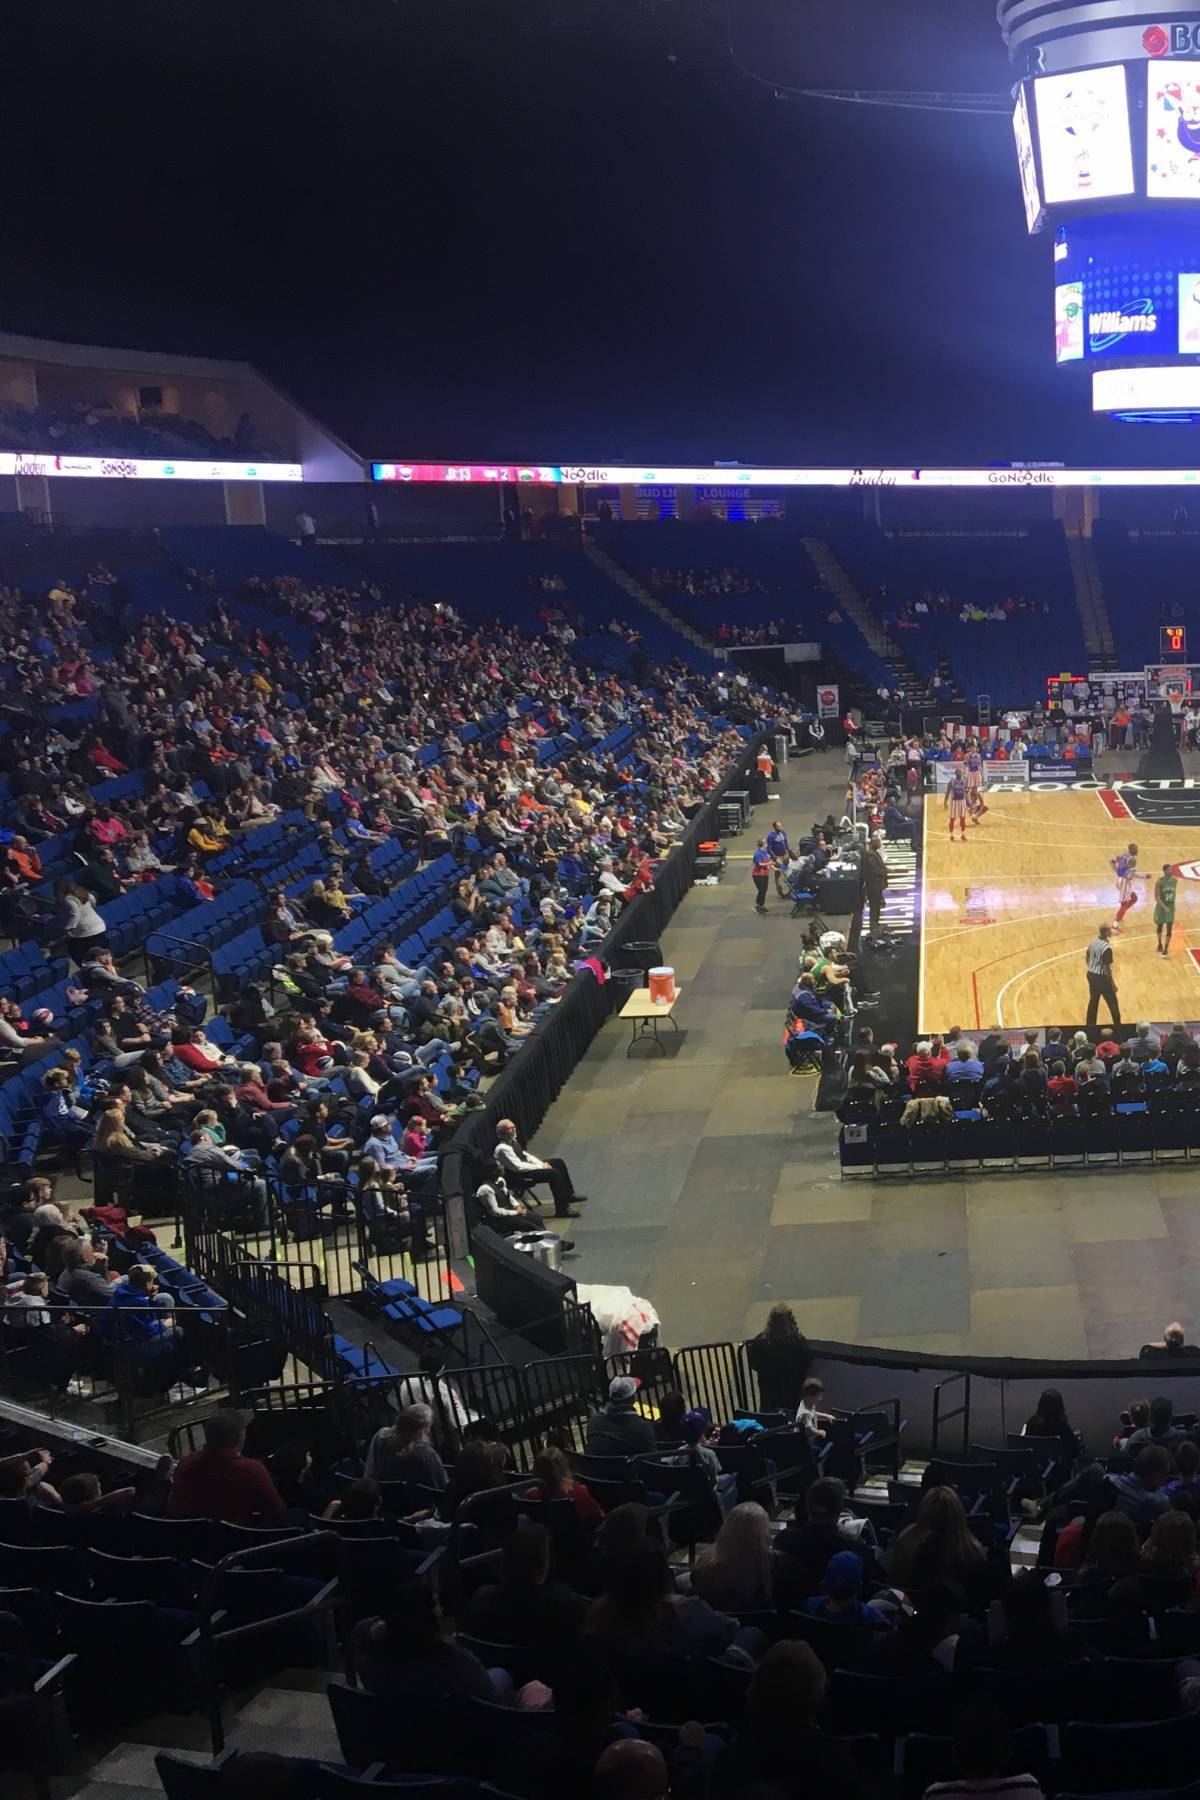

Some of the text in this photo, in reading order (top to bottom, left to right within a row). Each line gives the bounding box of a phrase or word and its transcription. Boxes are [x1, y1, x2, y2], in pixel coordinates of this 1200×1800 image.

[1088, 310, 1157, 335] Williams
[988, 470, 1055, 486] GoNoodle
[703, 487, 751, 499] LOUNGE
